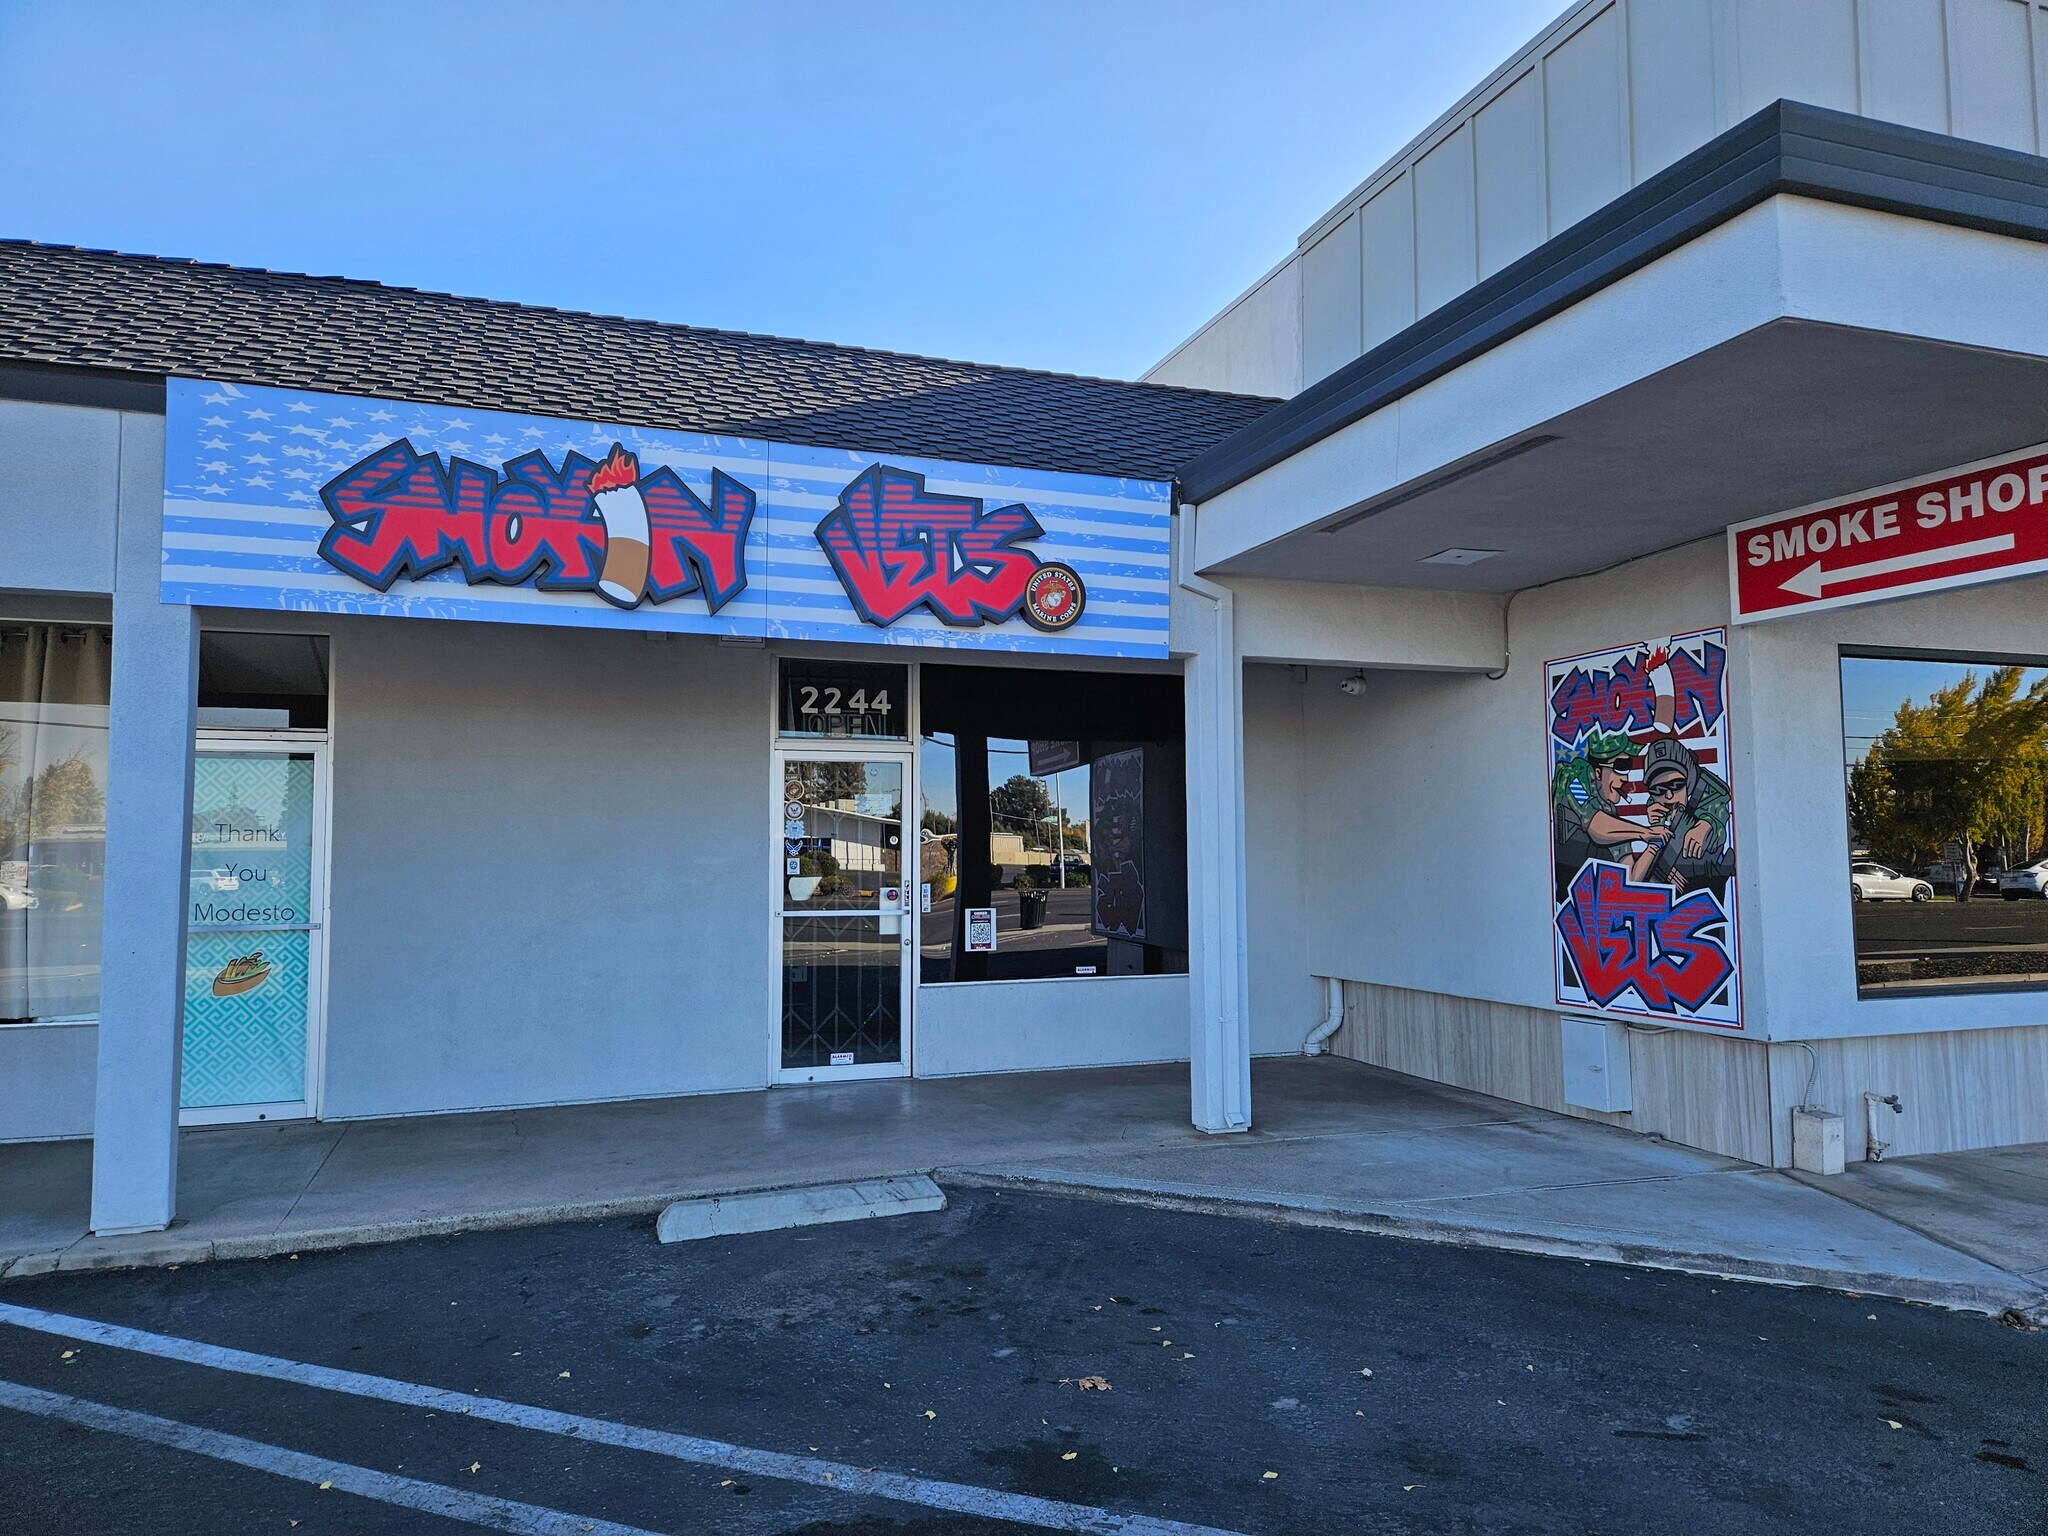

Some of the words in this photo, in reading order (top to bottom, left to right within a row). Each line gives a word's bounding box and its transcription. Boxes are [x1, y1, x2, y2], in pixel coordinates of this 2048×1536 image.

[1747, 501, 1901, 567] SMOKE
[1030, 571, 1053, 592] UNITED
[1054, 571, 1076, 591] STATES
[1032, 602, 1057, 622] MARINE
[1059, 602, 1077, 621] CORPS
[800, 685, 892, 715] 2244
[214, 823, 280, 842] Thank
[225, 863, 267, 882] You
[194, 903, 295, 922] Modesto
